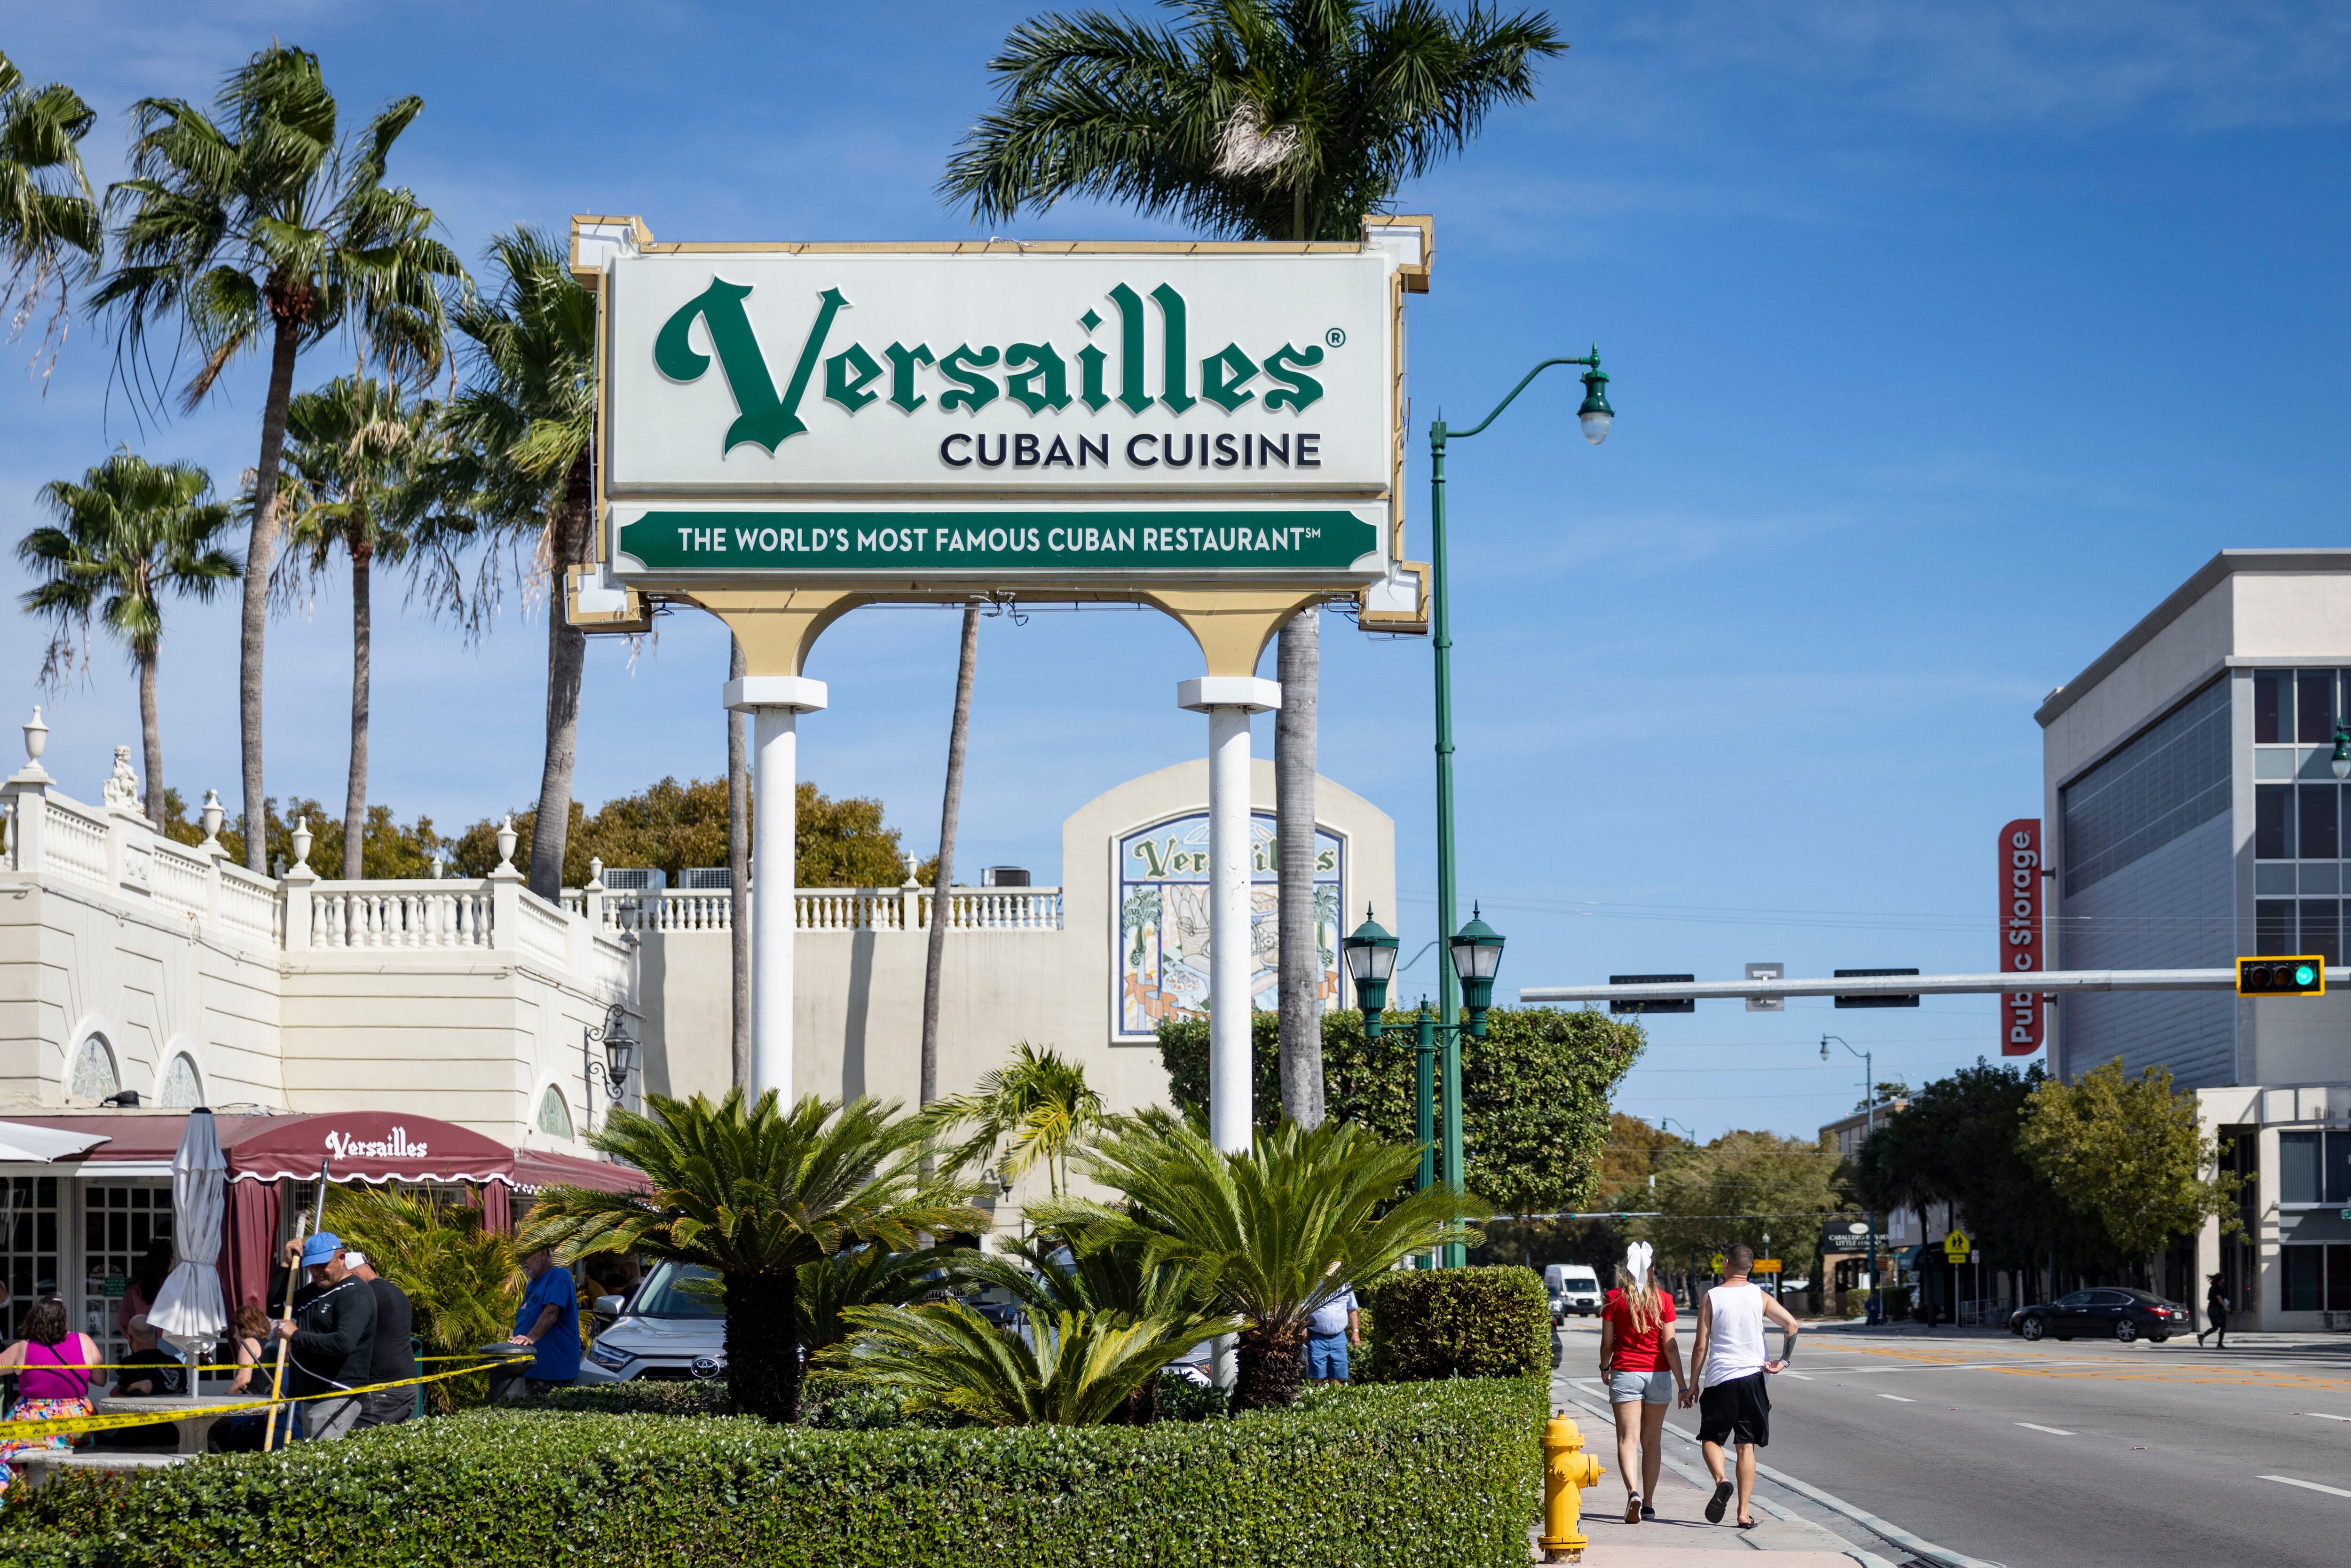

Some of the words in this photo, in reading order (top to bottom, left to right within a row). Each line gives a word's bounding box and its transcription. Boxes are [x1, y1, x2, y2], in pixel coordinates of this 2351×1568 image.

[940, 433, 1109, 466] CUBAN
[1127, 433, 1321, 466] CUISINE
[678, 528, 726, 552] THE
[734, 528, 849, 552] WORLD'S
[858, 528, 928, 552] MOST
[936, 528, 1040, 552] FAMOUS
[1048, 528, 1135, 551] CUBAN
[1134, 837, 1336, 878] Verils
[2009, 831, 2038, 946] Storage
[2010, 953, 2034, 1043] Pubc
[324, 1126, 427, 1161] Versailles
